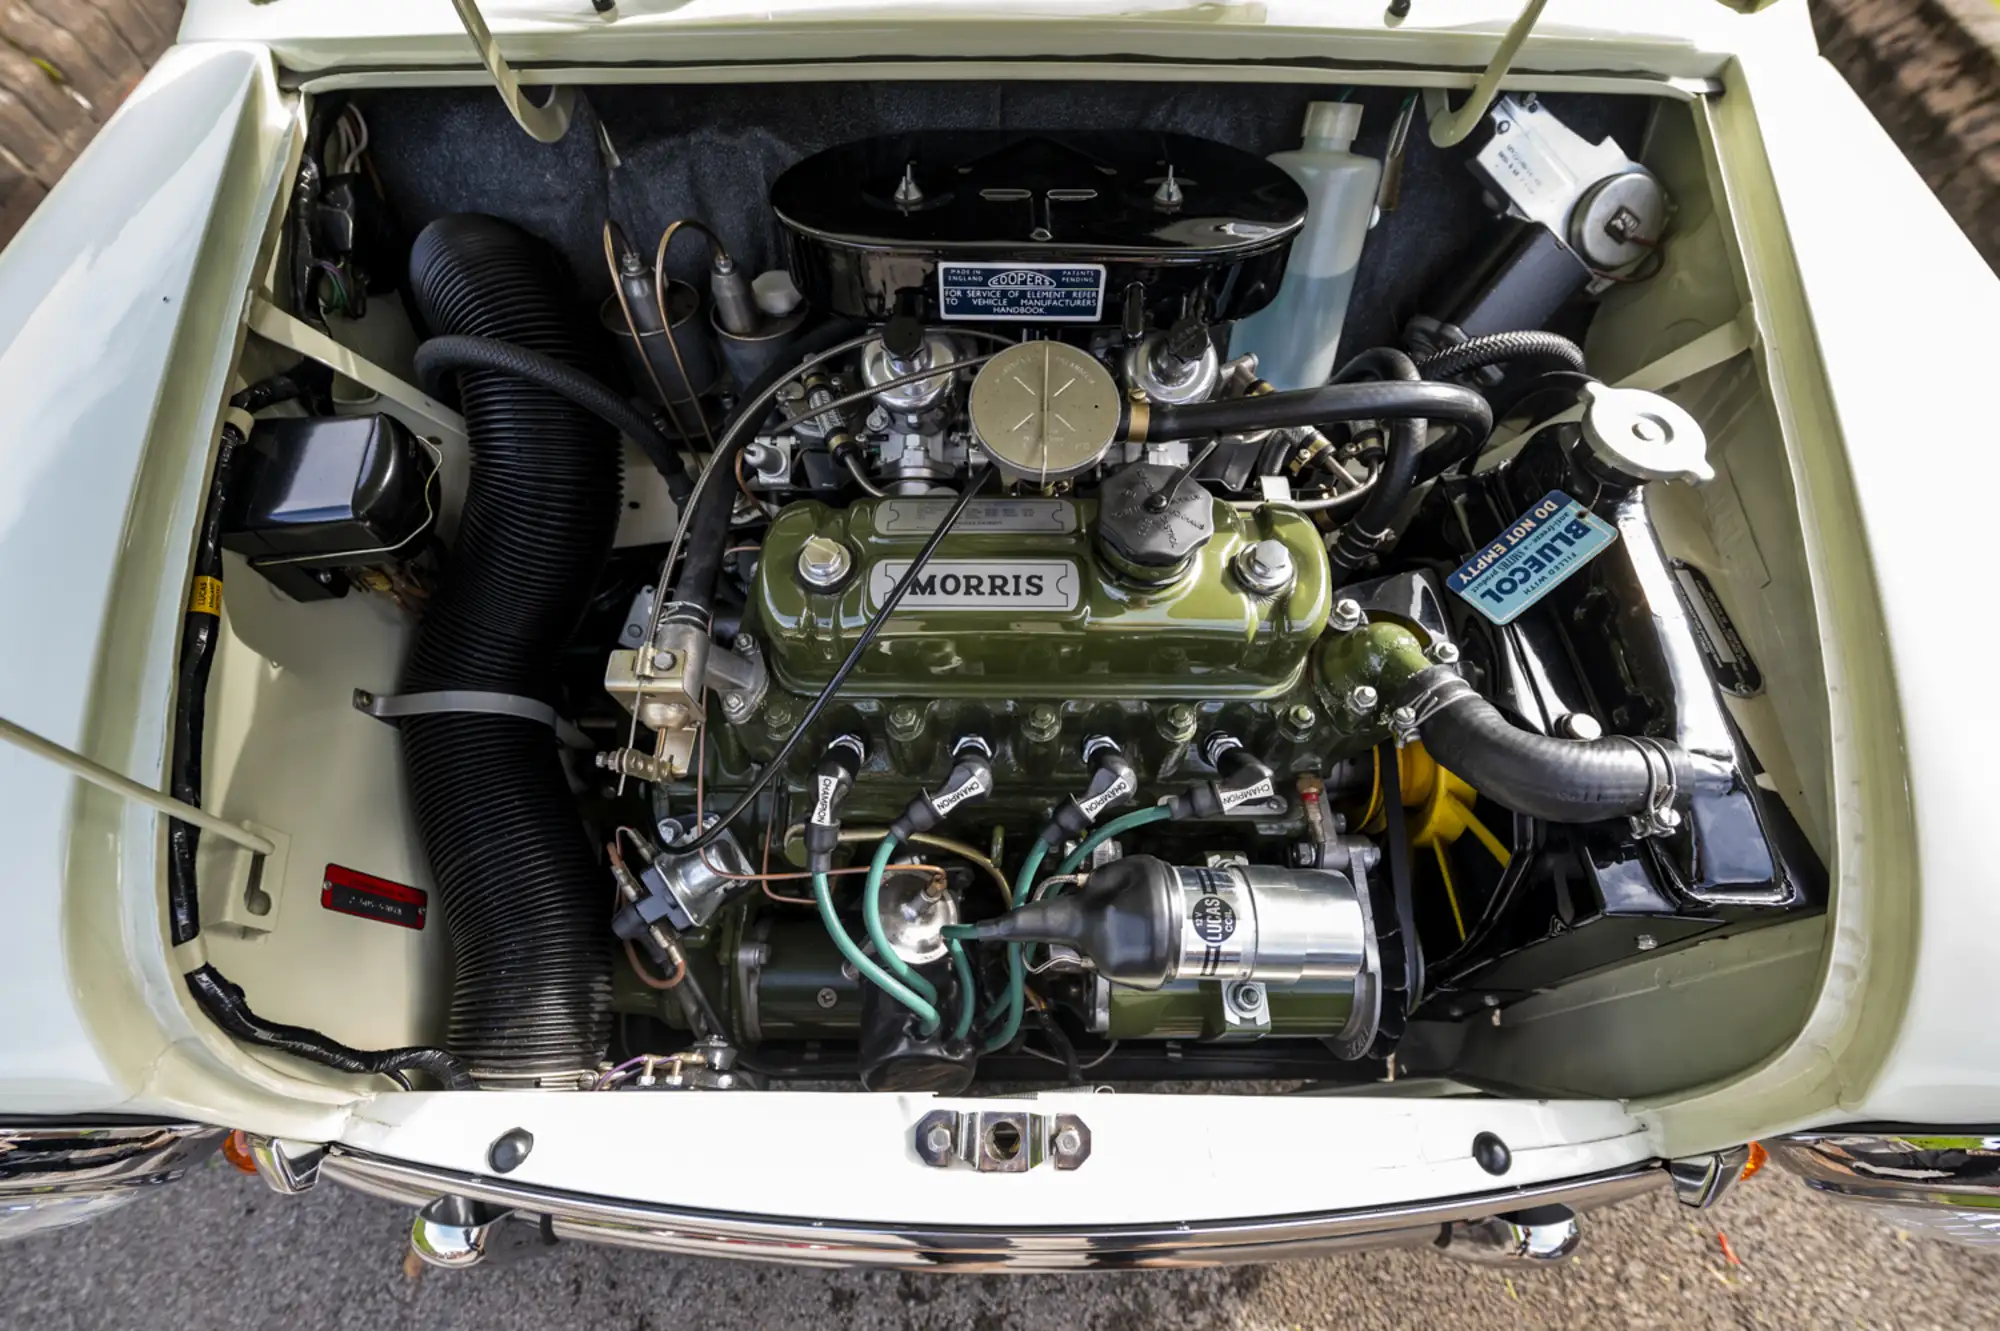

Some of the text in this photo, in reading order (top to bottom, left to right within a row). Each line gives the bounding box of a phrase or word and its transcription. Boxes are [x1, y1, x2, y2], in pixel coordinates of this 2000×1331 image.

[992, 272, 1050, 286] COOPERS
[966, 290, 1001, 298] SERVICE
[972, 298, 1008, 306] VEHICLE
[1020, 299, 1097, 307] MANUFACTURERS
[1458, 499, 1559, 585] DO NOT EMPTY
[1479, 518, 1592, 604] BLUECOL
[1500, 548, 1526, 573] SMITHS
[1522, 551, 1578, 596] FILLED WITH
[198, 582, 207, 605] LUCAS
[909, 573, 1044, 597] MORRIS
[1472, 566, 1500, 594] product
[816, 778, 833, 824] CHAMPION
[937, 781, 980, 810] CHAMPION
[1085, 781, 1127, 814] CHAMPION
[1223, 783, 1271, 804] CHAMPION
[1204, 898, 1222, 941] LUCAS
